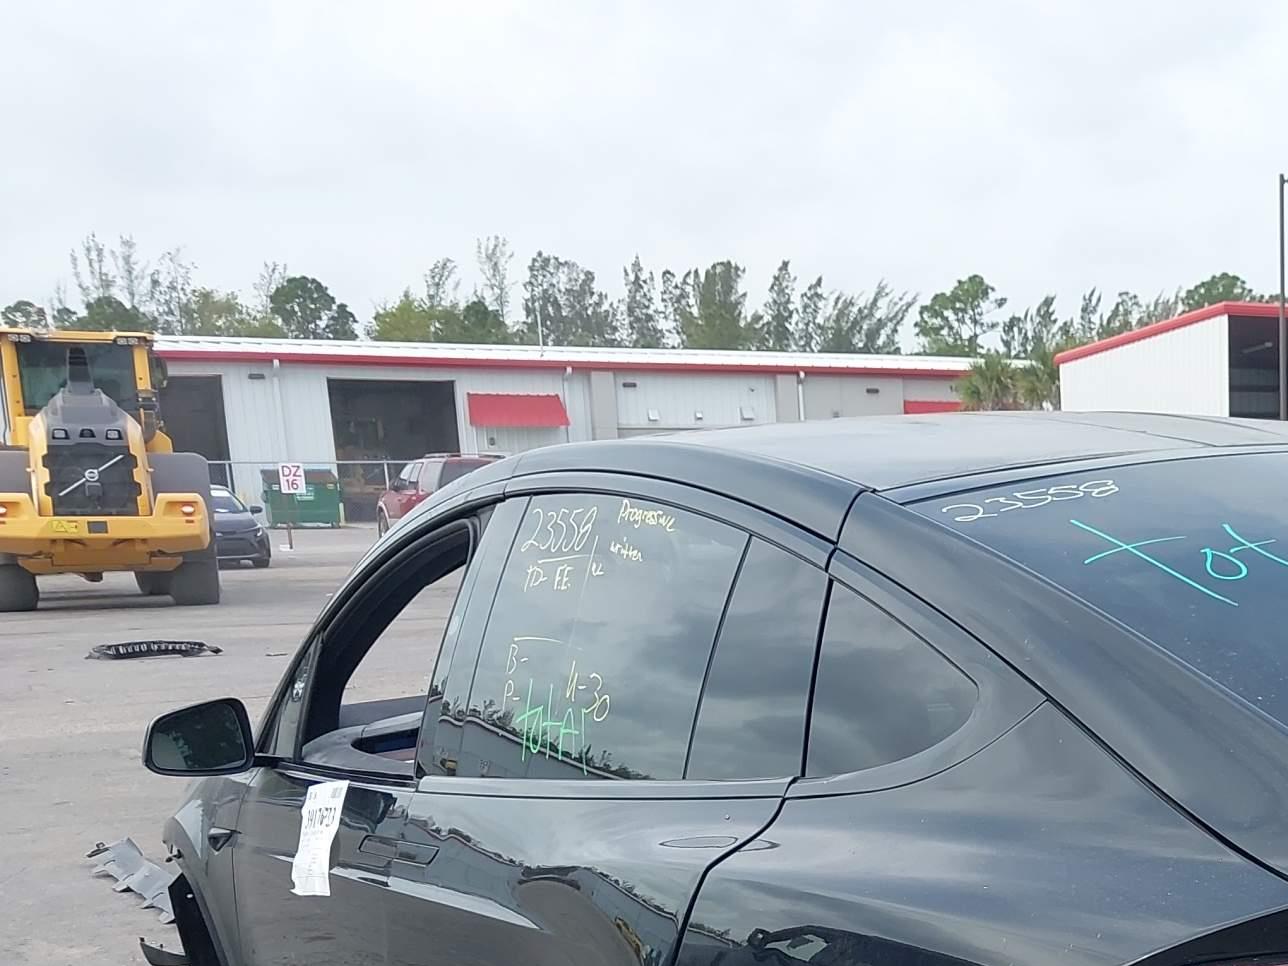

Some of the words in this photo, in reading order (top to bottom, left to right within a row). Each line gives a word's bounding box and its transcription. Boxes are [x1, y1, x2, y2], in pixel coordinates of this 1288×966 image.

[281, 465, 302, 478] DZ
[286, 479, 299, 490] 16
[941, 480, 1120, 522] 23558
[521, 506, 598, 552] 23558
